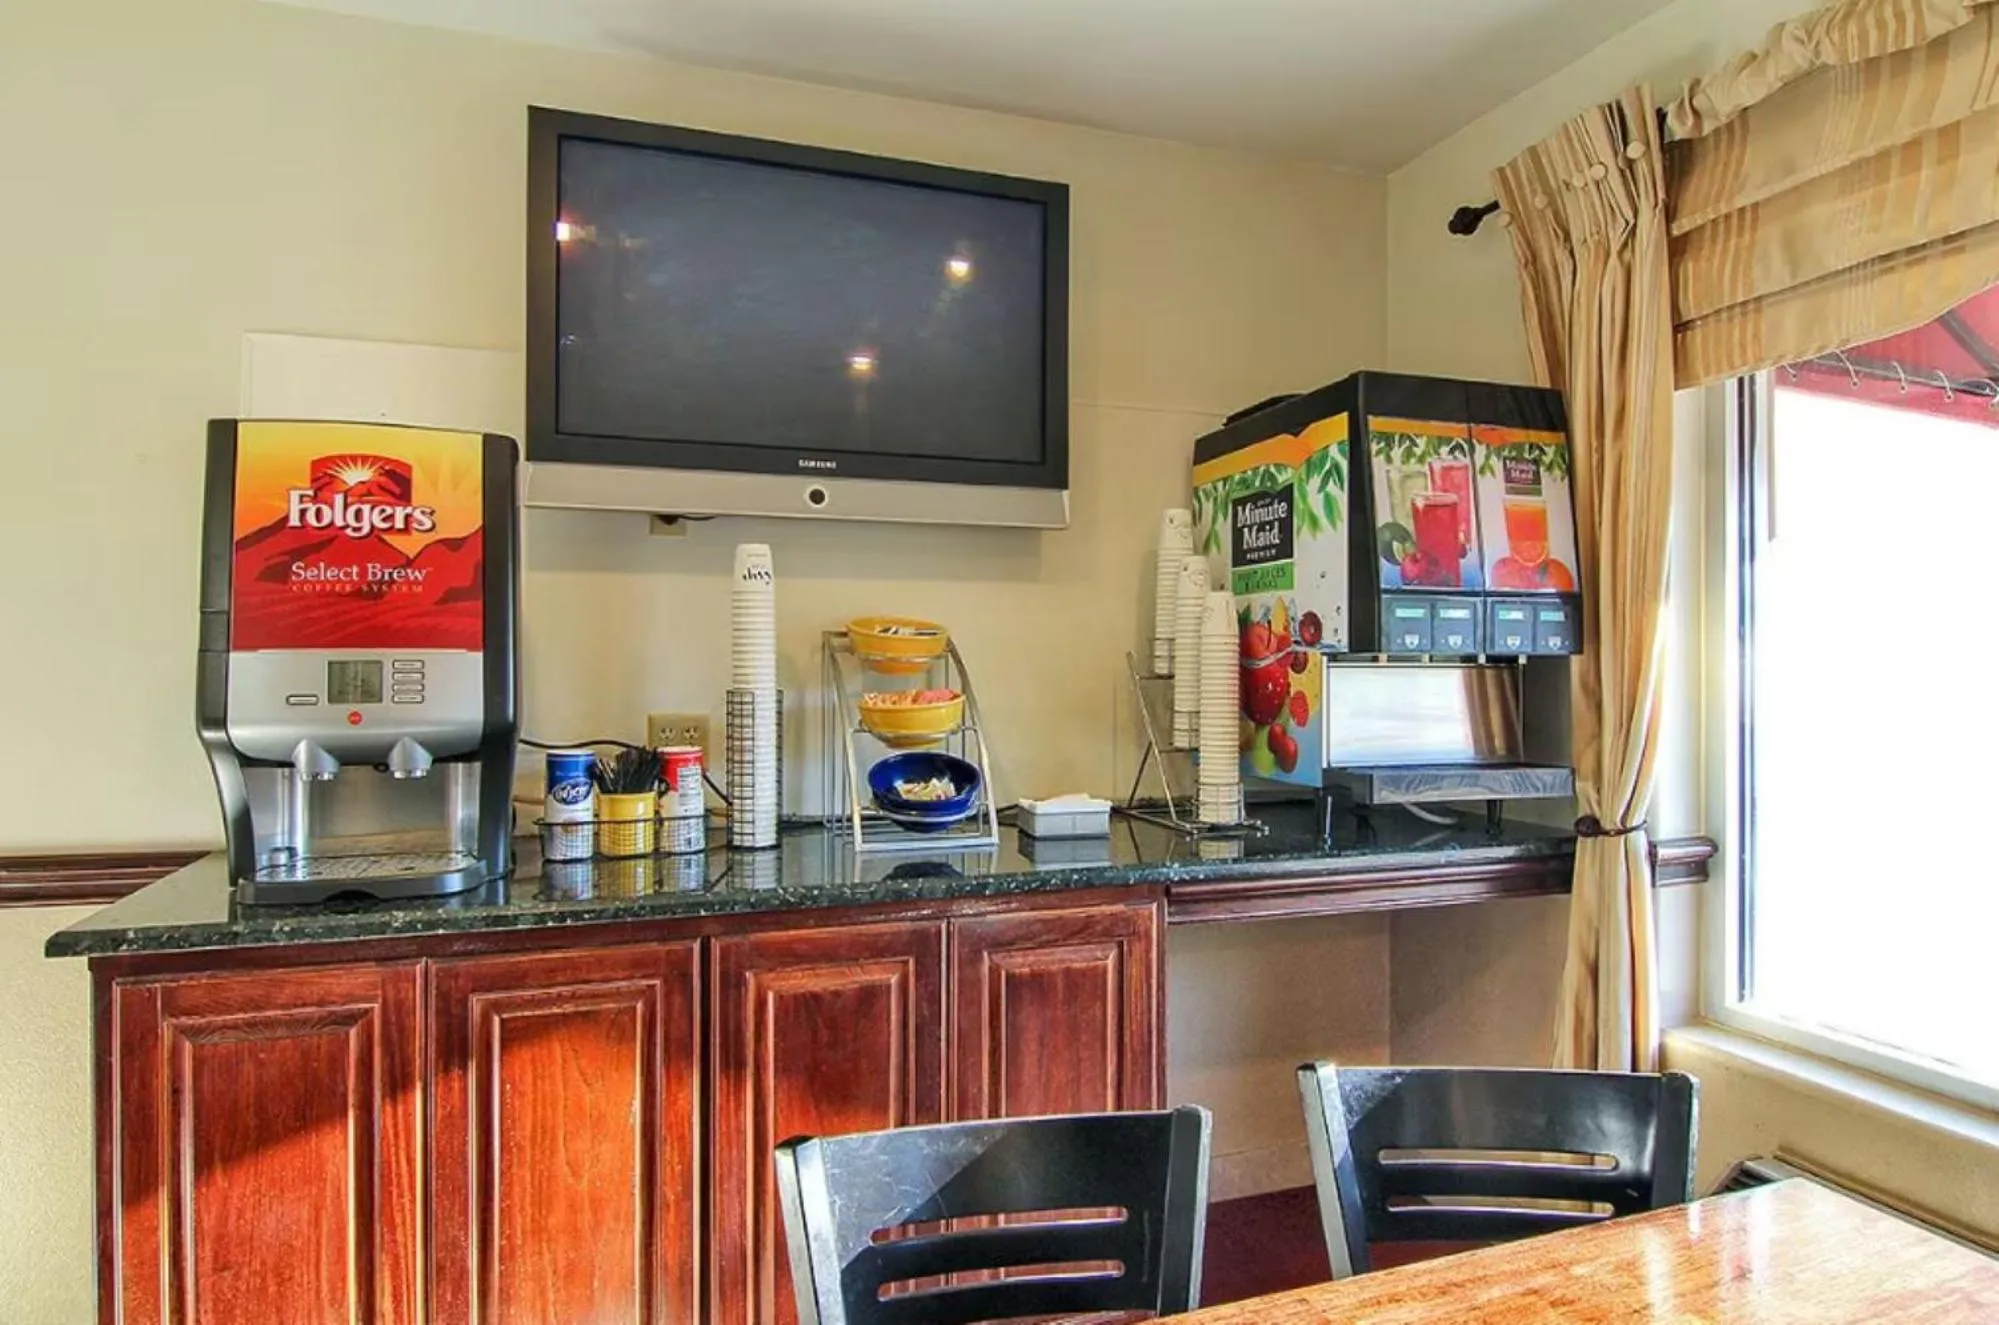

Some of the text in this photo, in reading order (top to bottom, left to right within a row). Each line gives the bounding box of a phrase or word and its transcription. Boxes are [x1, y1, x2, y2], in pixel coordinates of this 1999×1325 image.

[287, 488, 435, 538] Folgers
[1237, 499, 1288, 528] Minute
[1242, 521, 1280, 550] Maid
[291, 561, 427, 582] Select Brew
[292, 583, 423, 593] COFFEE SYSTEM
